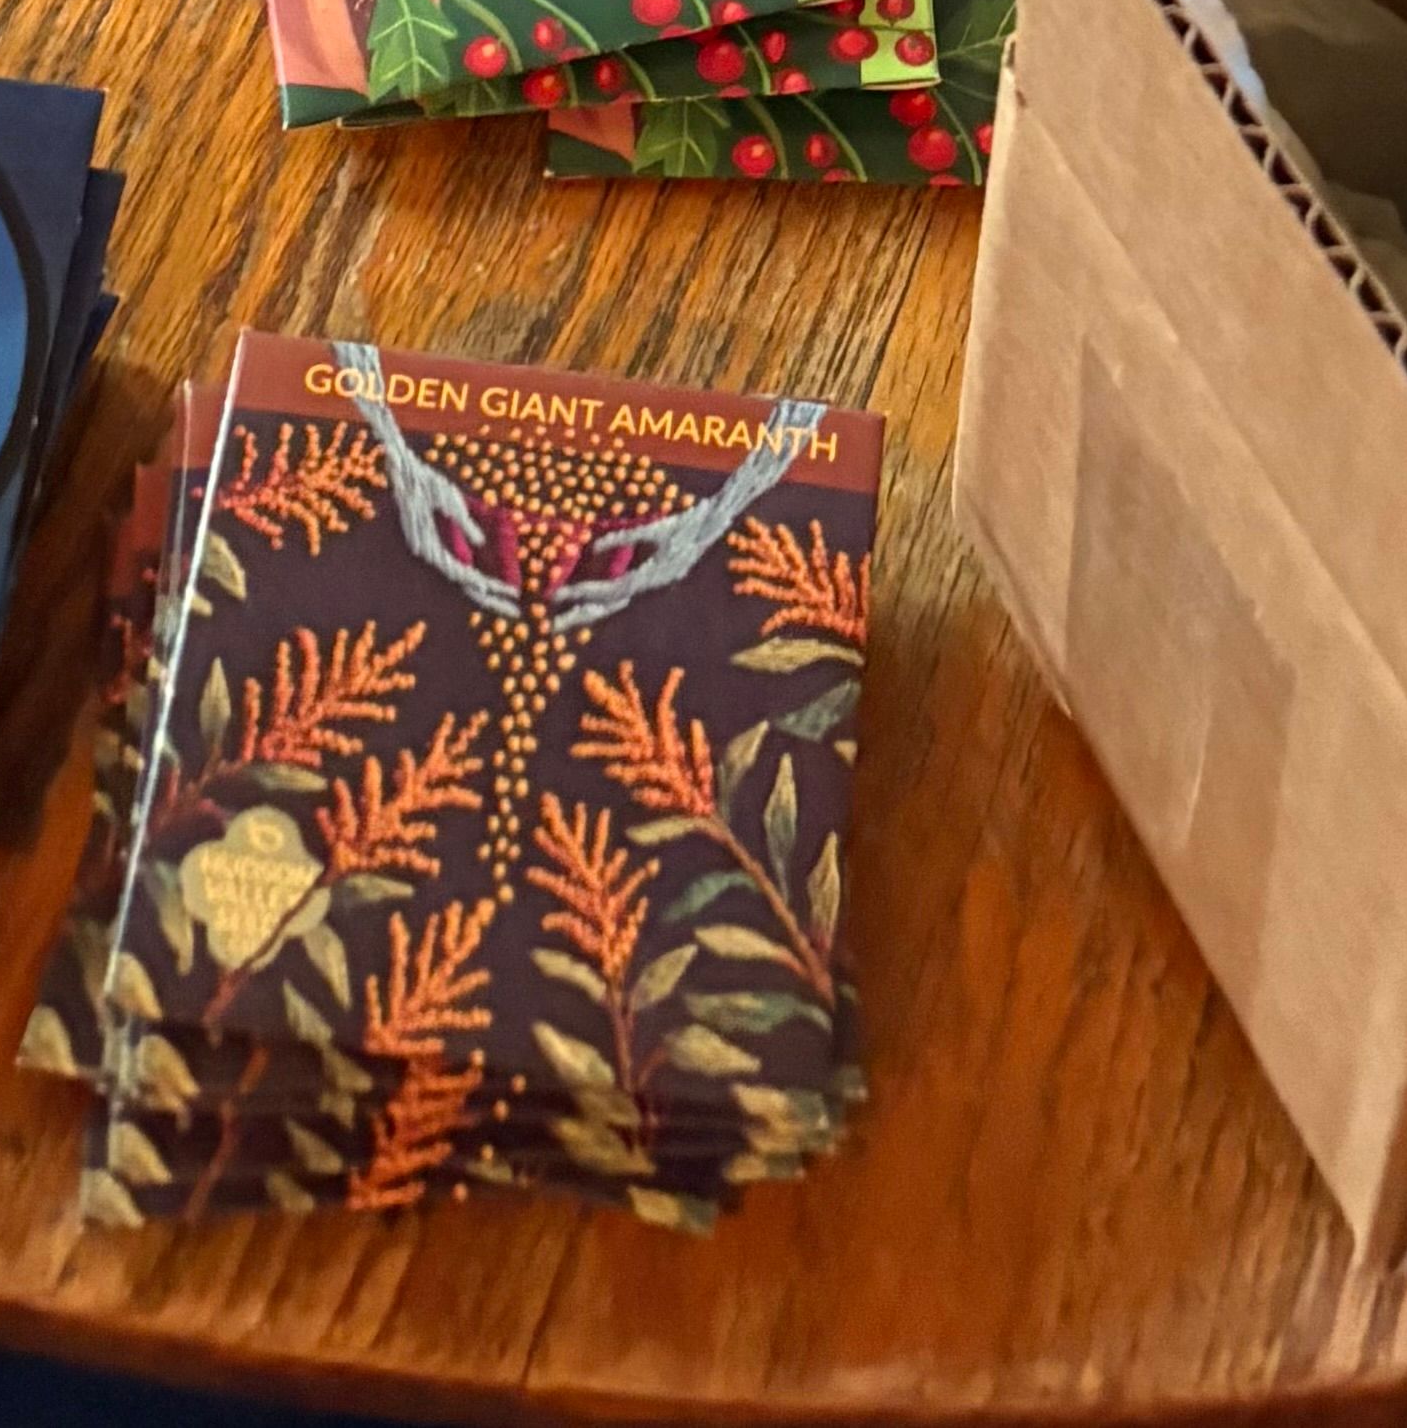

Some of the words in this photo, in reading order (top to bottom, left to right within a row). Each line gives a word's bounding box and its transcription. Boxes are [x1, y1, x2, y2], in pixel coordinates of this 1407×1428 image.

[304, 361, 469, 413] GOLDEN
[479, 386, 604, 429] GIANT
[607, 404, 838, 463] AMARANTH
